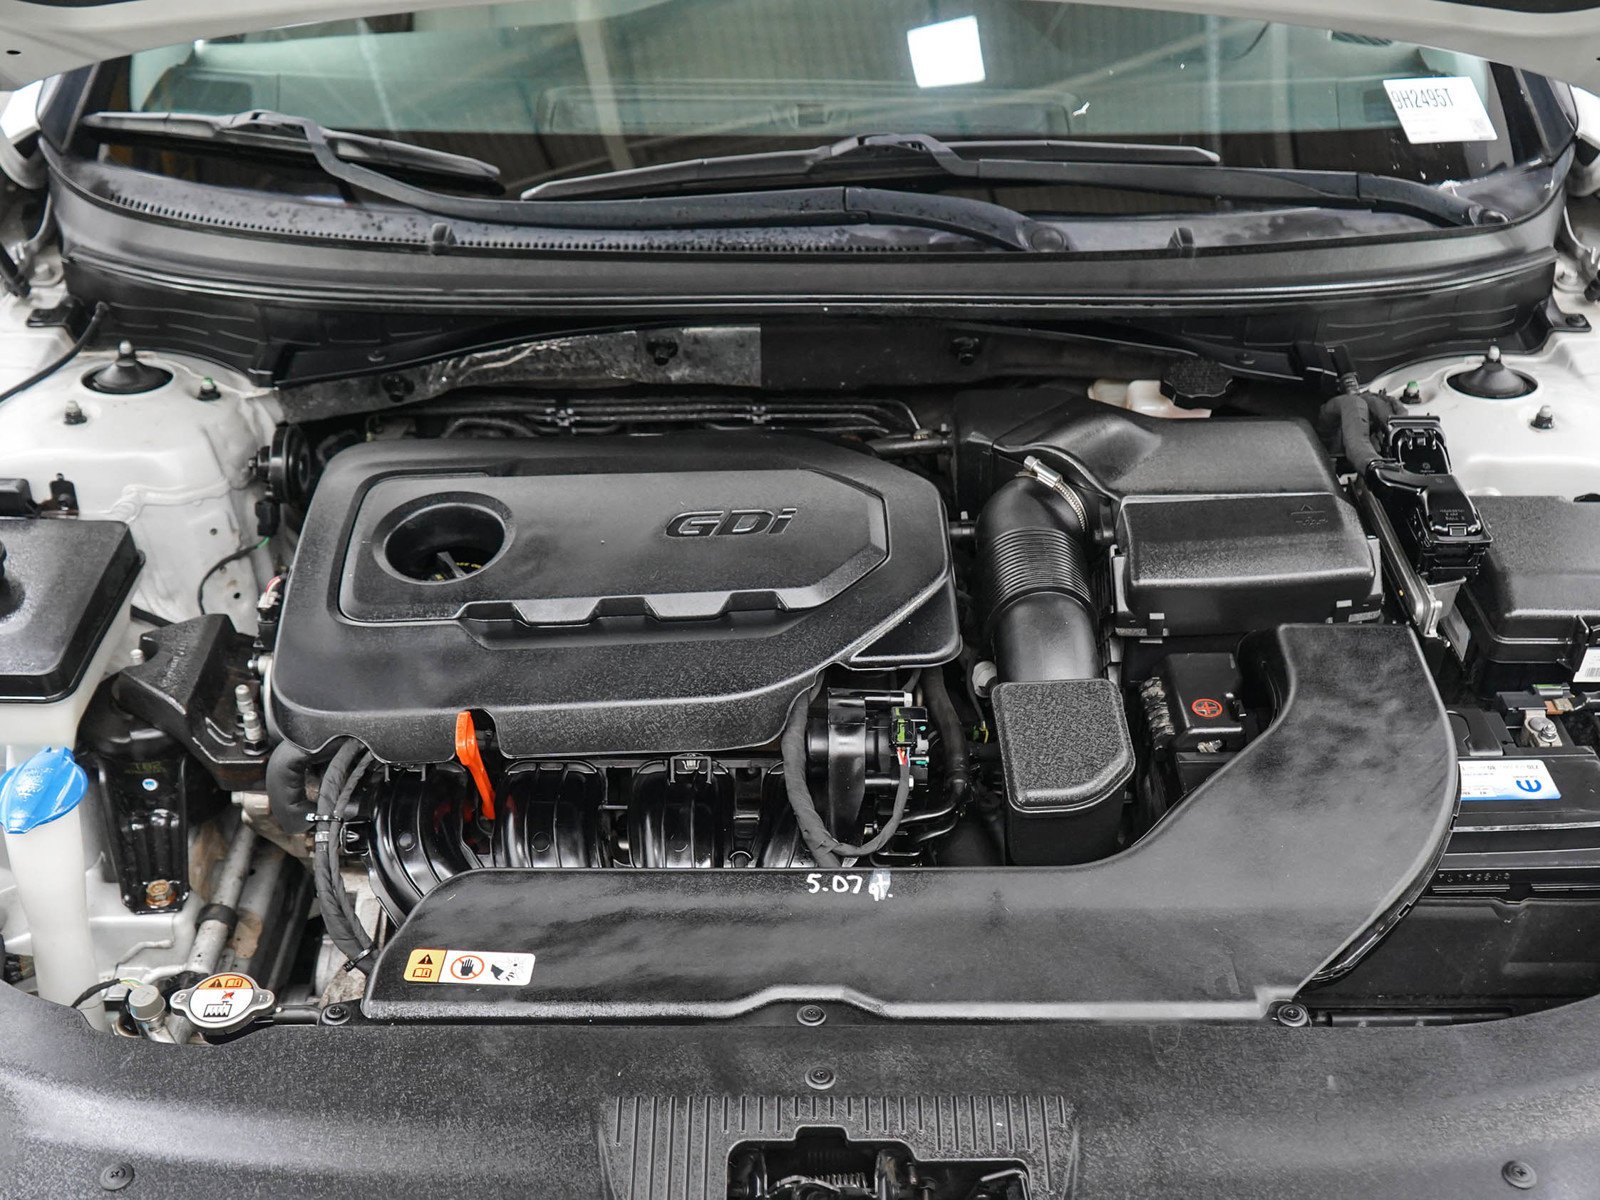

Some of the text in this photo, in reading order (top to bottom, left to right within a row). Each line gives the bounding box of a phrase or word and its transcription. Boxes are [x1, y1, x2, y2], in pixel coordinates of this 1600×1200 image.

[1390, 88, 1454, 110] 9H2495T
[665, 507, 798, 538] GDi
[806, 873, 863, 894] 5.07
